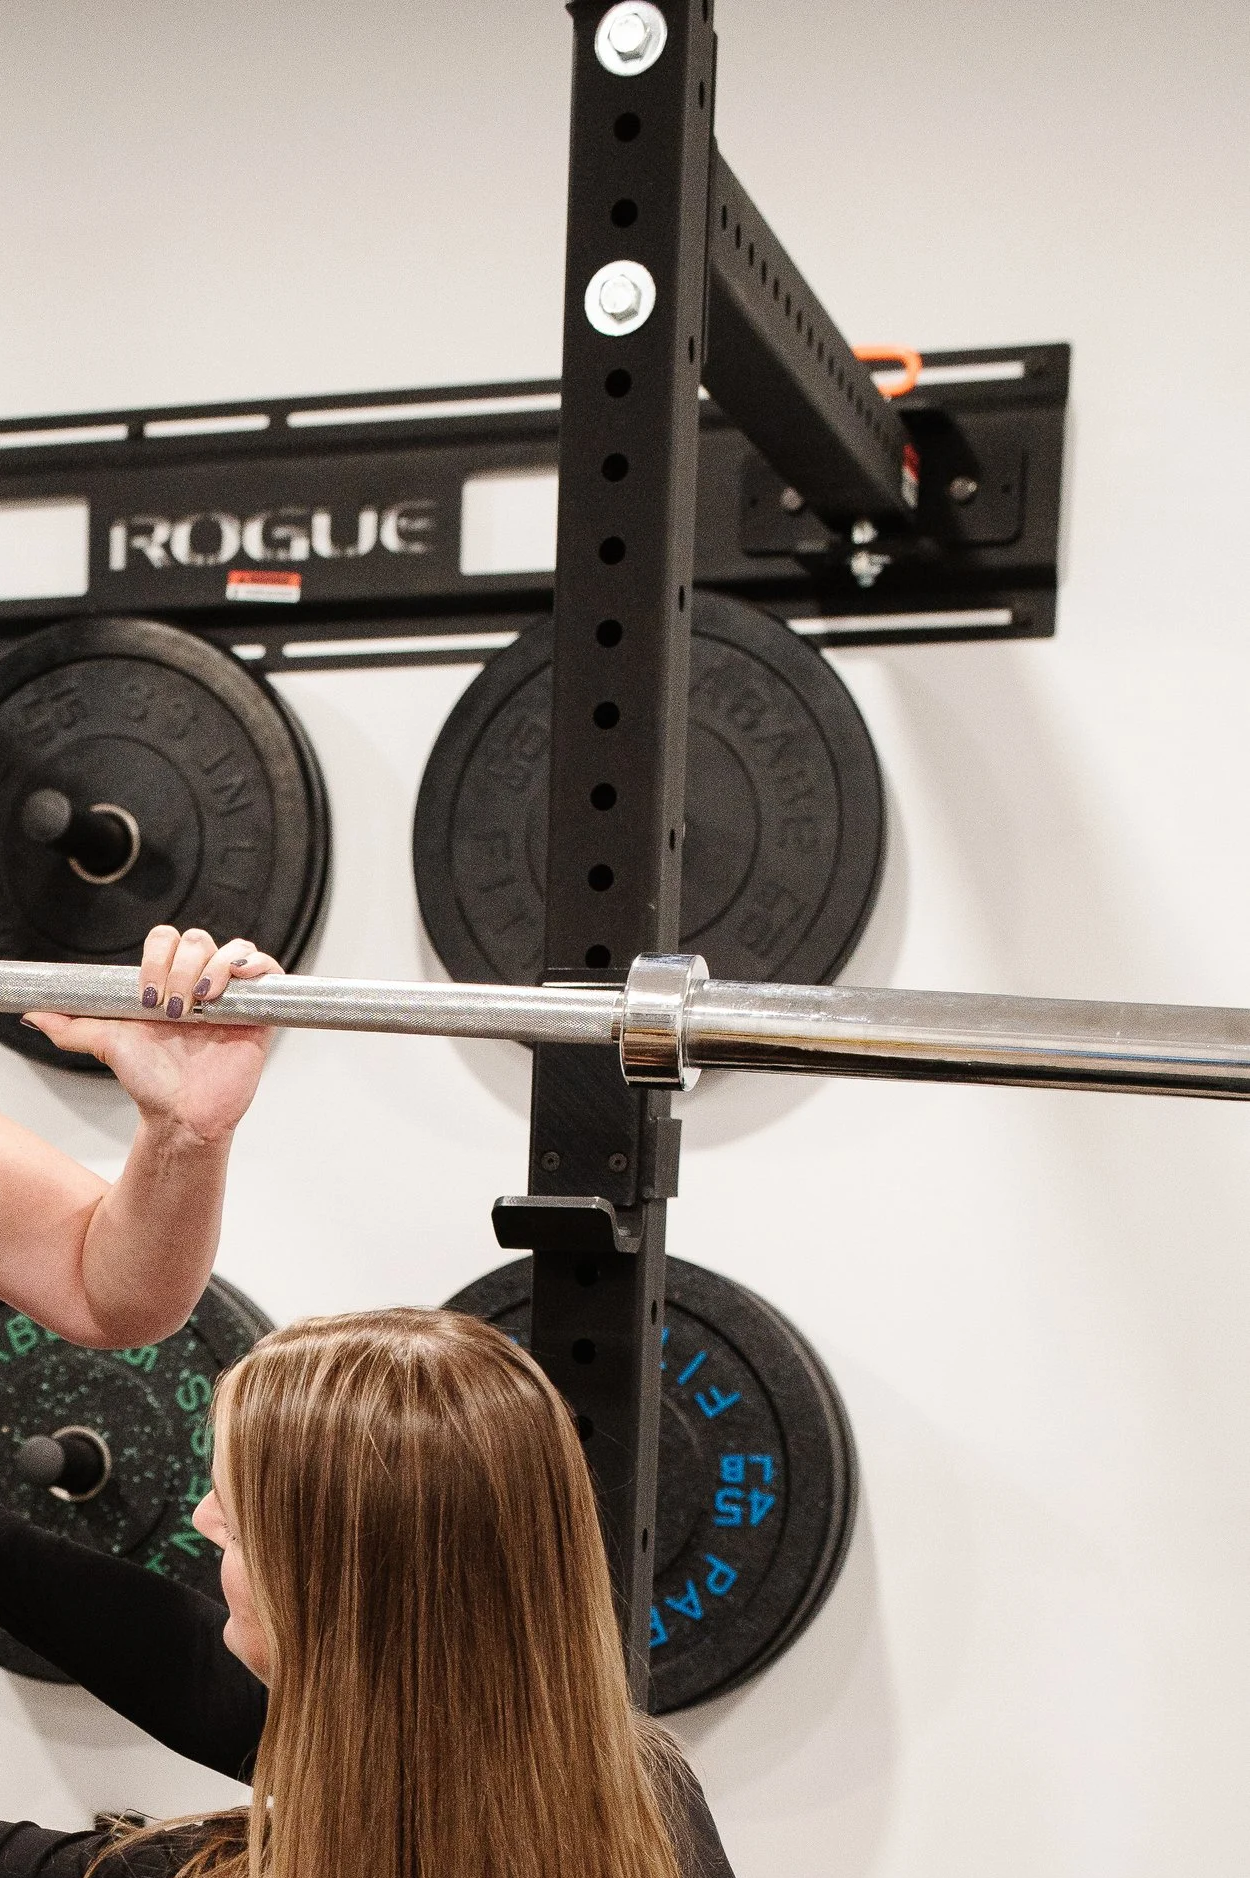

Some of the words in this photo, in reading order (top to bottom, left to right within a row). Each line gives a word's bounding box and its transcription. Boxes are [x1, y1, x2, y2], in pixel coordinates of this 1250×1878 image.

[107, 499, 437, 572] ROGUE
[720, 1454, 773, 1485] LB
[712, 1487, 776, 1527] 45
